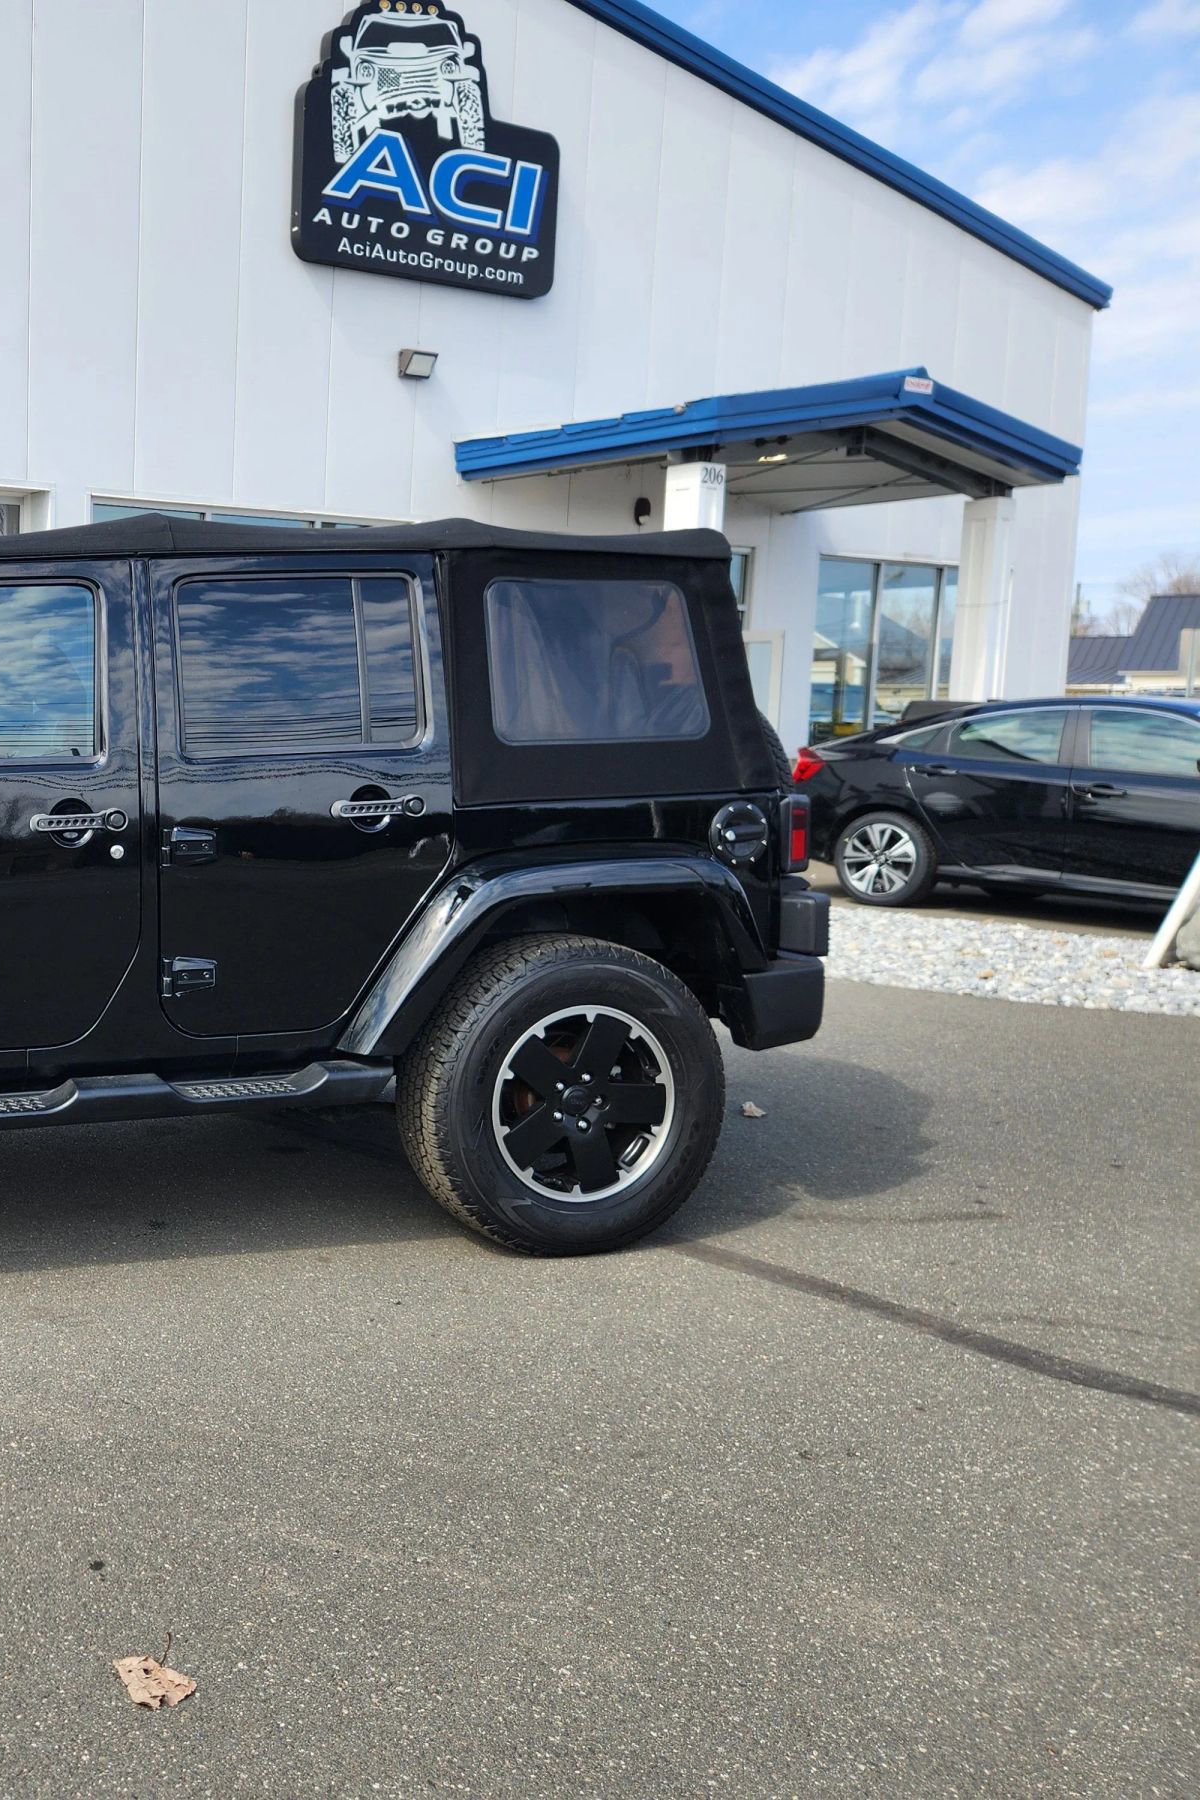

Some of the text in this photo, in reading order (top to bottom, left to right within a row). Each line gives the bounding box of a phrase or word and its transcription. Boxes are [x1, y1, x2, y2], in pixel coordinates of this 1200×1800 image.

[321, 127, 543, 237] ACI
[312, 207, 540, 263] AUTO GROUP
[337, 237, 524, 285] AciAutoGroup.com
[701, 466, 724, 485] 206
